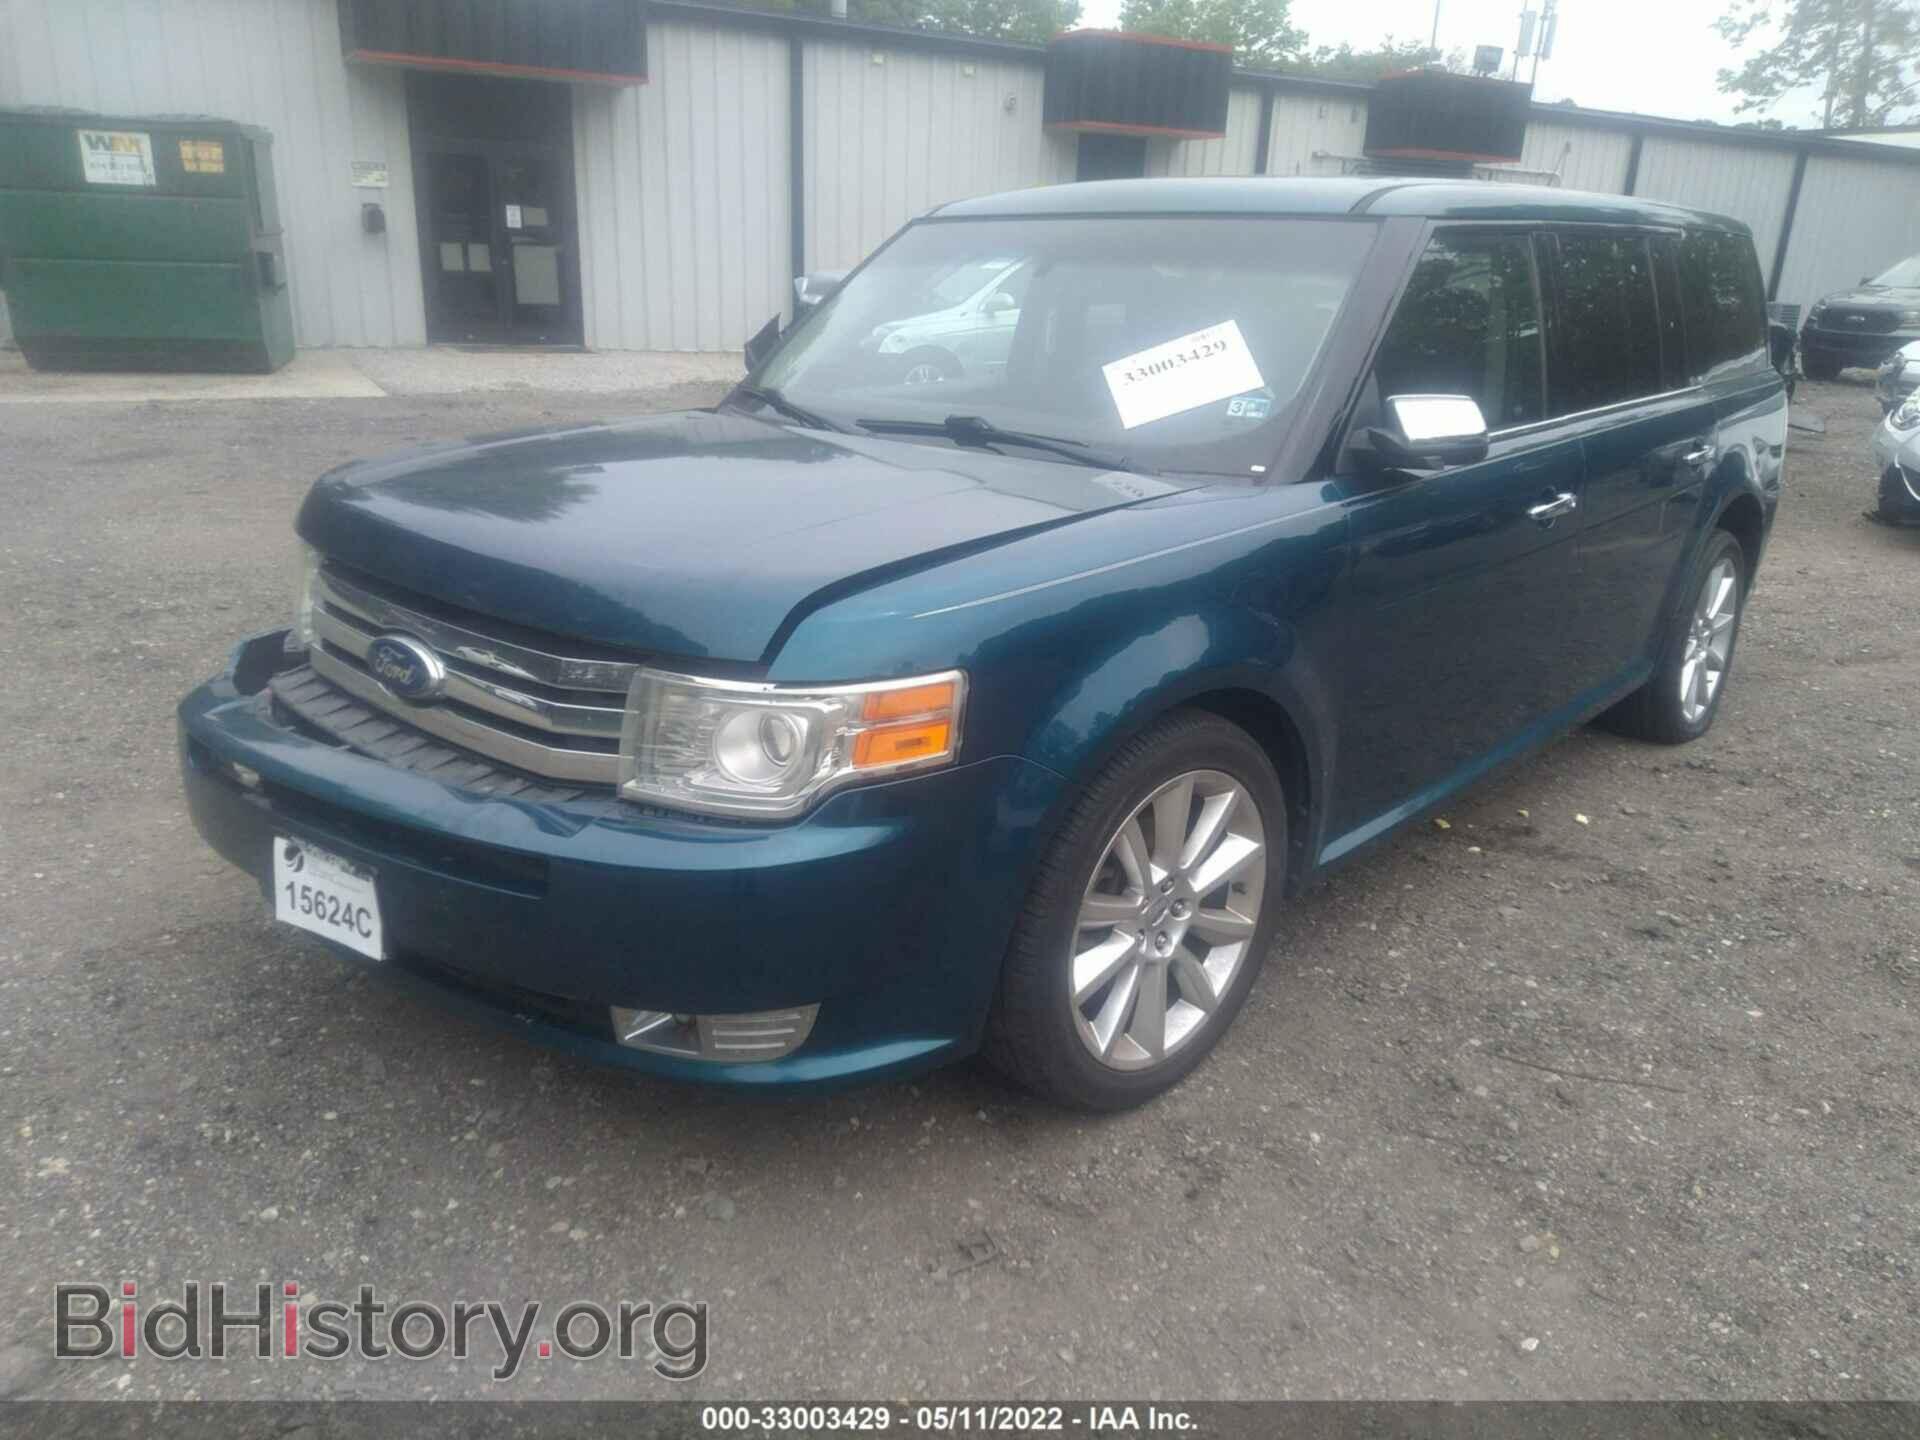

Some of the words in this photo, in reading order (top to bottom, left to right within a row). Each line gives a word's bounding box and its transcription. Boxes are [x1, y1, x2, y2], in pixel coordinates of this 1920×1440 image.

[1122, 339, 1228, 386] 33003429
[374, 645, 418, 686] Ford
[284, 880, 373, 939] 15624C
